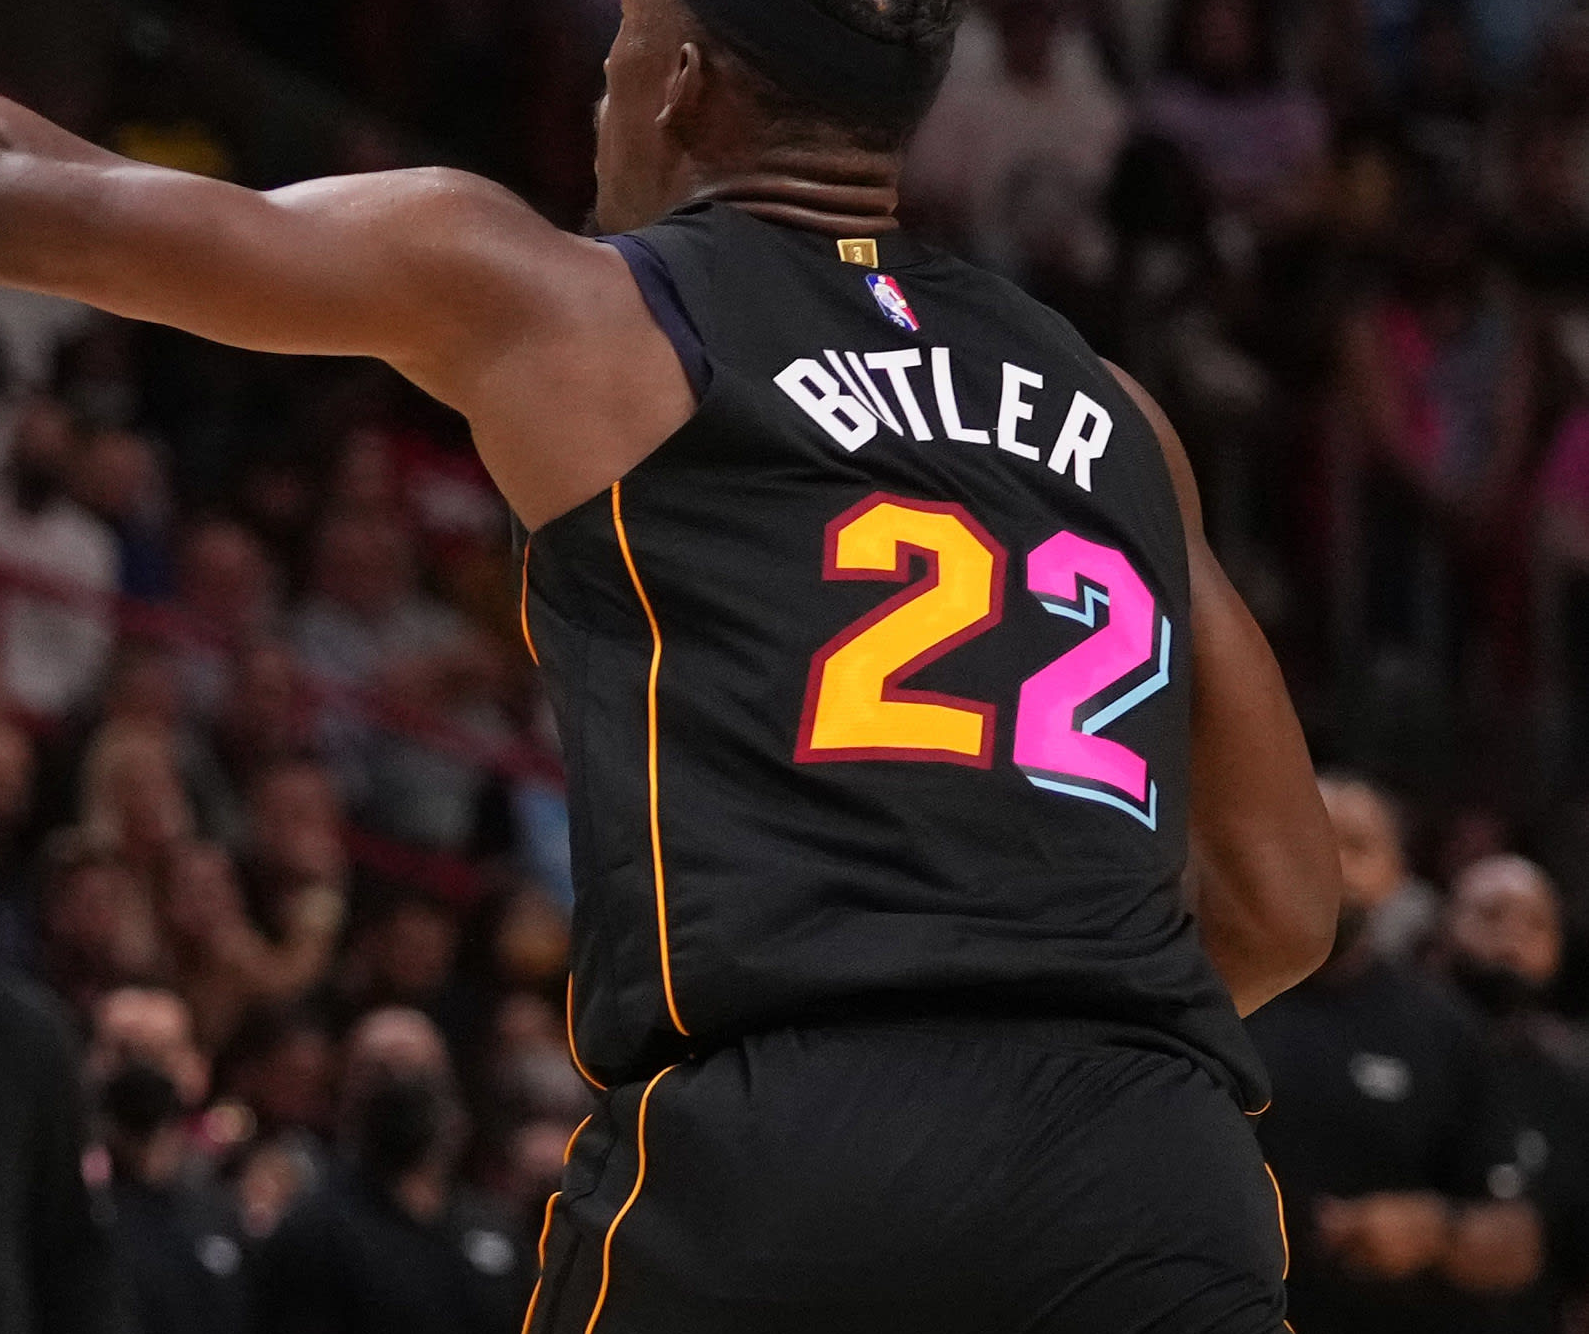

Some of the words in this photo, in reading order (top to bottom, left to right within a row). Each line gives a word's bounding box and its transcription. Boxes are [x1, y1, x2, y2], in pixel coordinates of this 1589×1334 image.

[853, 246, 863, 263] 3
[773, 347, 1113, 492] BUTLER
[794, 491, 1171, 831] 22
